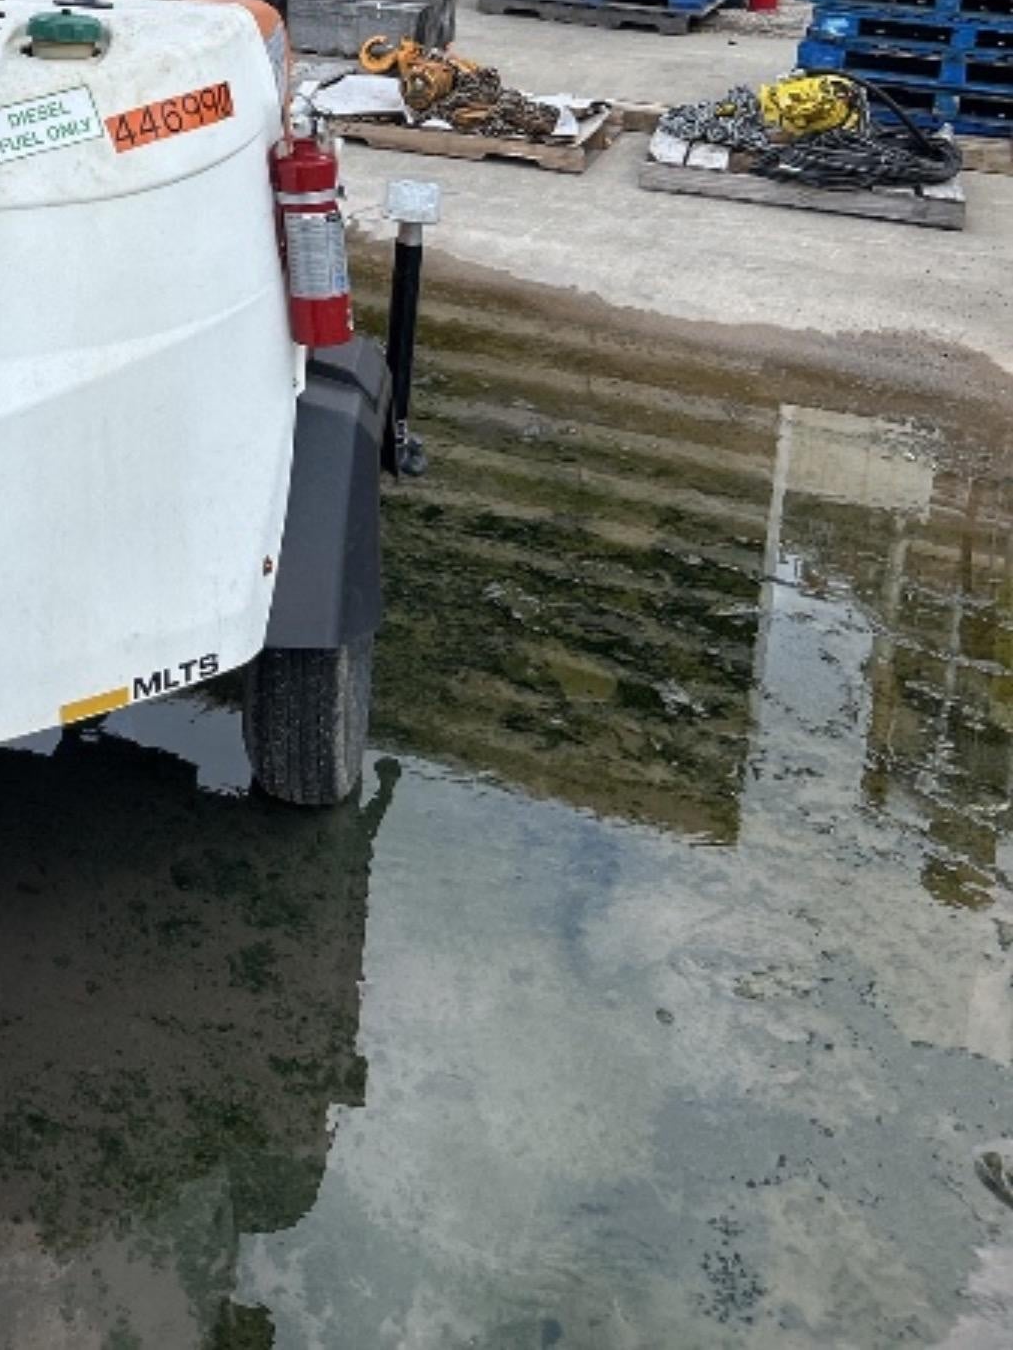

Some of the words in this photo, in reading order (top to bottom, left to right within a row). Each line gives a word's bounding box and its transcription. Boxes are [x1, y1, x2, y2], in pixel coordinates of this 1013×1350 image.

[7, 100, 71, 129] DIESEL
[46, 116, 91, 142] ONLY
[114, 81, 231, 146] 446990
[133, 653, 219, 699] MLTS
